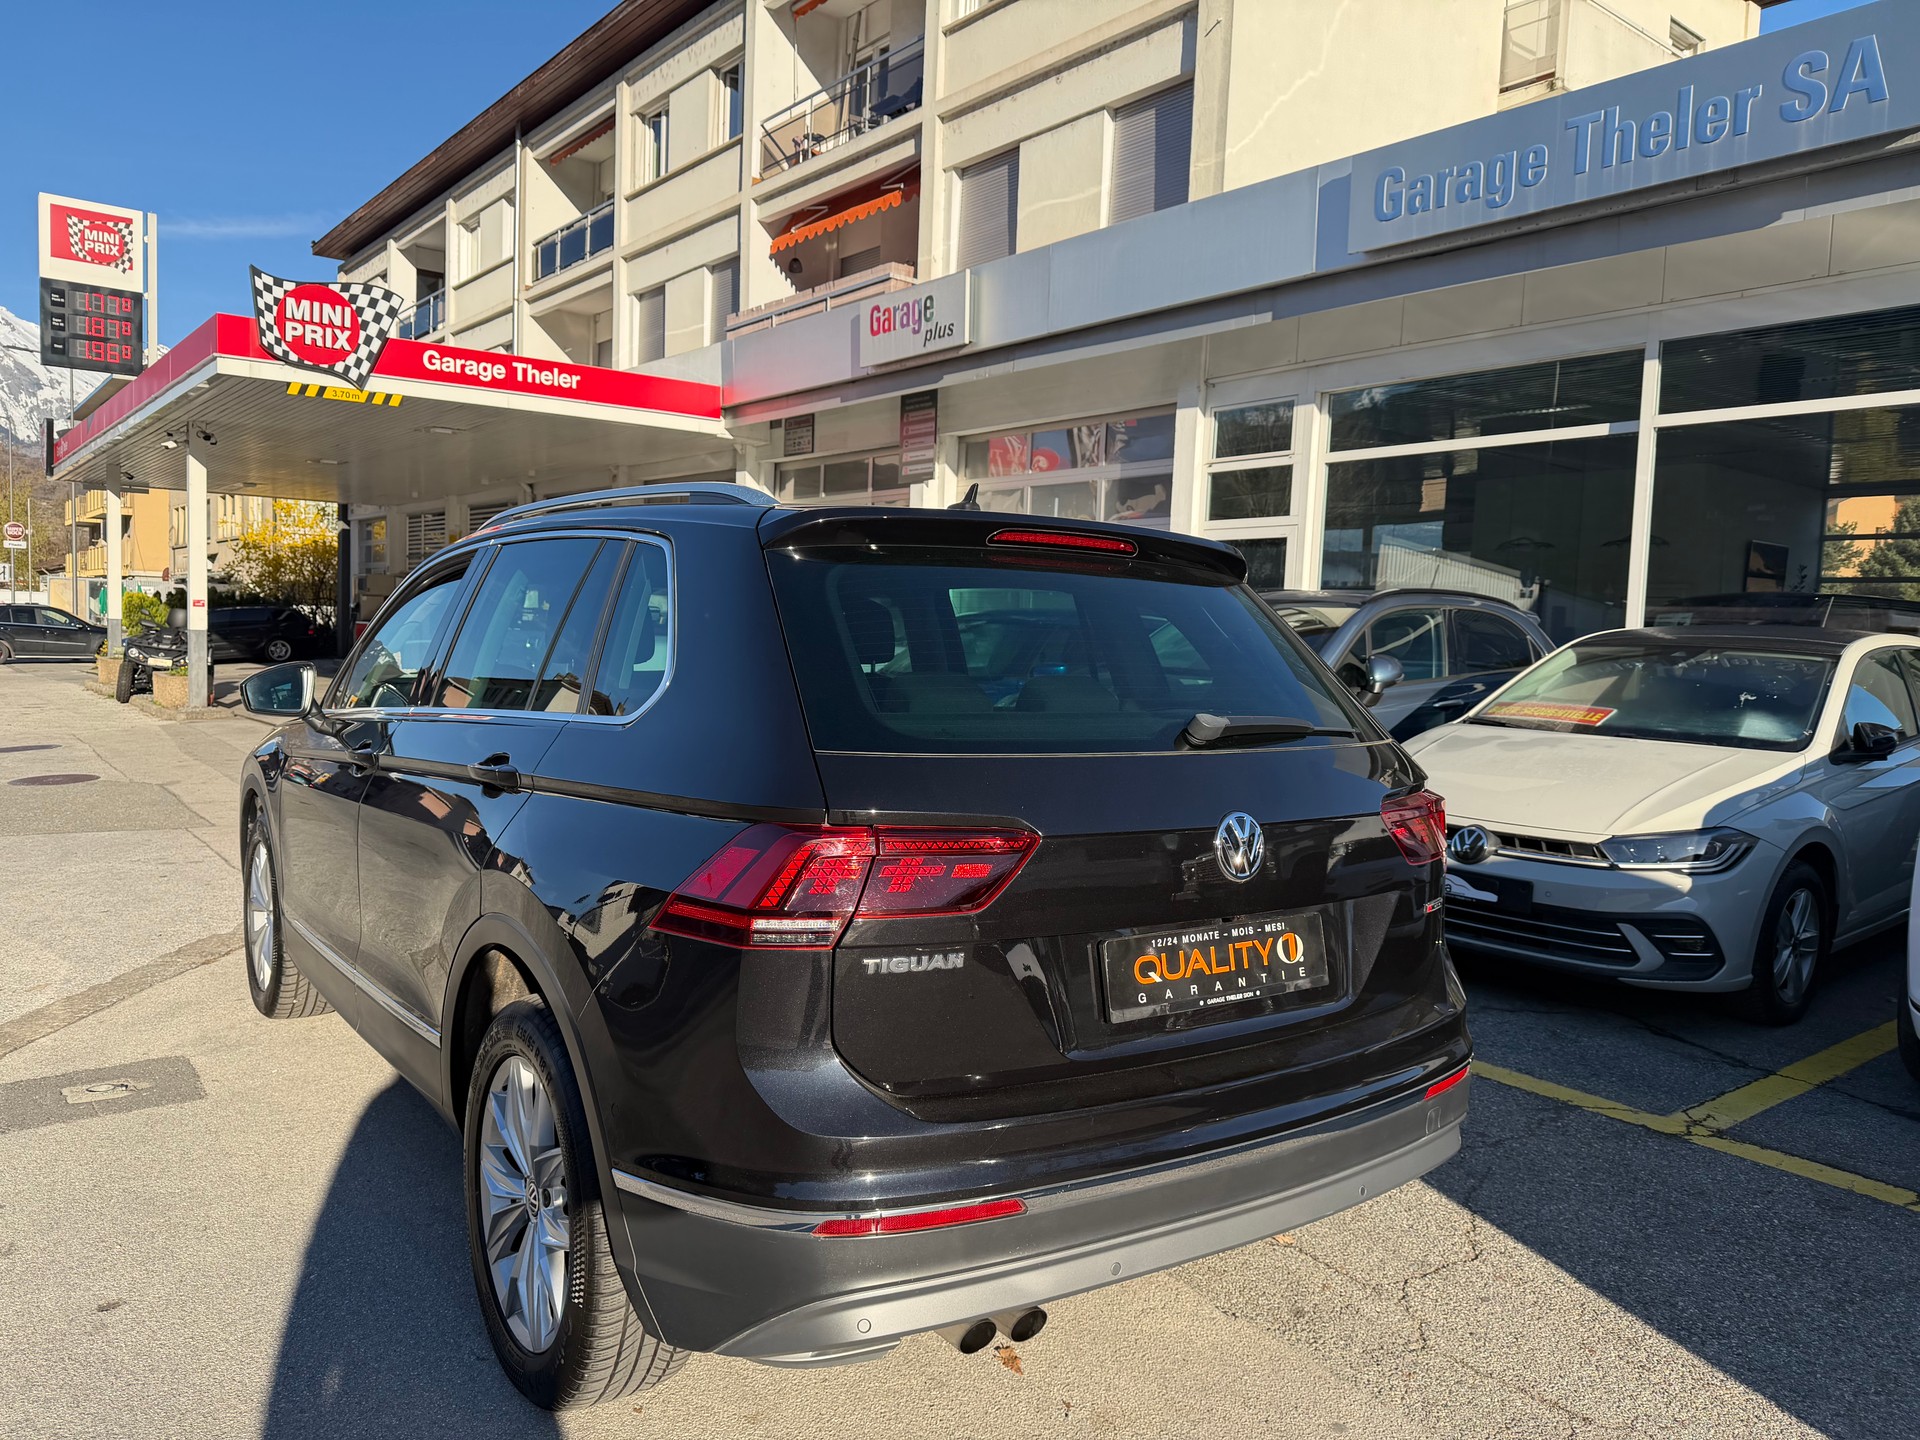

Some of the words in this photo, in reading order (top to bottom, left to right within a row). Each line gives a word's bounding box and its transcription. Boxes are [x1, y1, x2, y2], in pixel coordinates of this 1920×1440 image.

[1374, 143, 1549, 222] Garage
[1565, 83, 1763, 176] Theler
[1778, 33, 1890, 124] SA
[84, 229, 120, 245] MINI
[84, 240, 120, 257] PRIX
[285, 296, 352, 329] MINI
[870, 294, 935, 337] Garage
[285, 321, 352, 351] PRIX
[923, 321, 954, 348] plus
[422, 349, 507, 382] Garage
[512, 362, 581, 389] Theler
[1151, 937, 1178, 948] 12/24
[1182, 931, 1220, 944] MONATE
[1231, 926, 1254, 937] MOIS
[1264, 922, 1286, 932] MESI
[863, 952, 965, 974] TIGUAN
[1133, 937, 1274, 985] QUALITY
[1138, 966, 1306, 1004] GARANTIE
